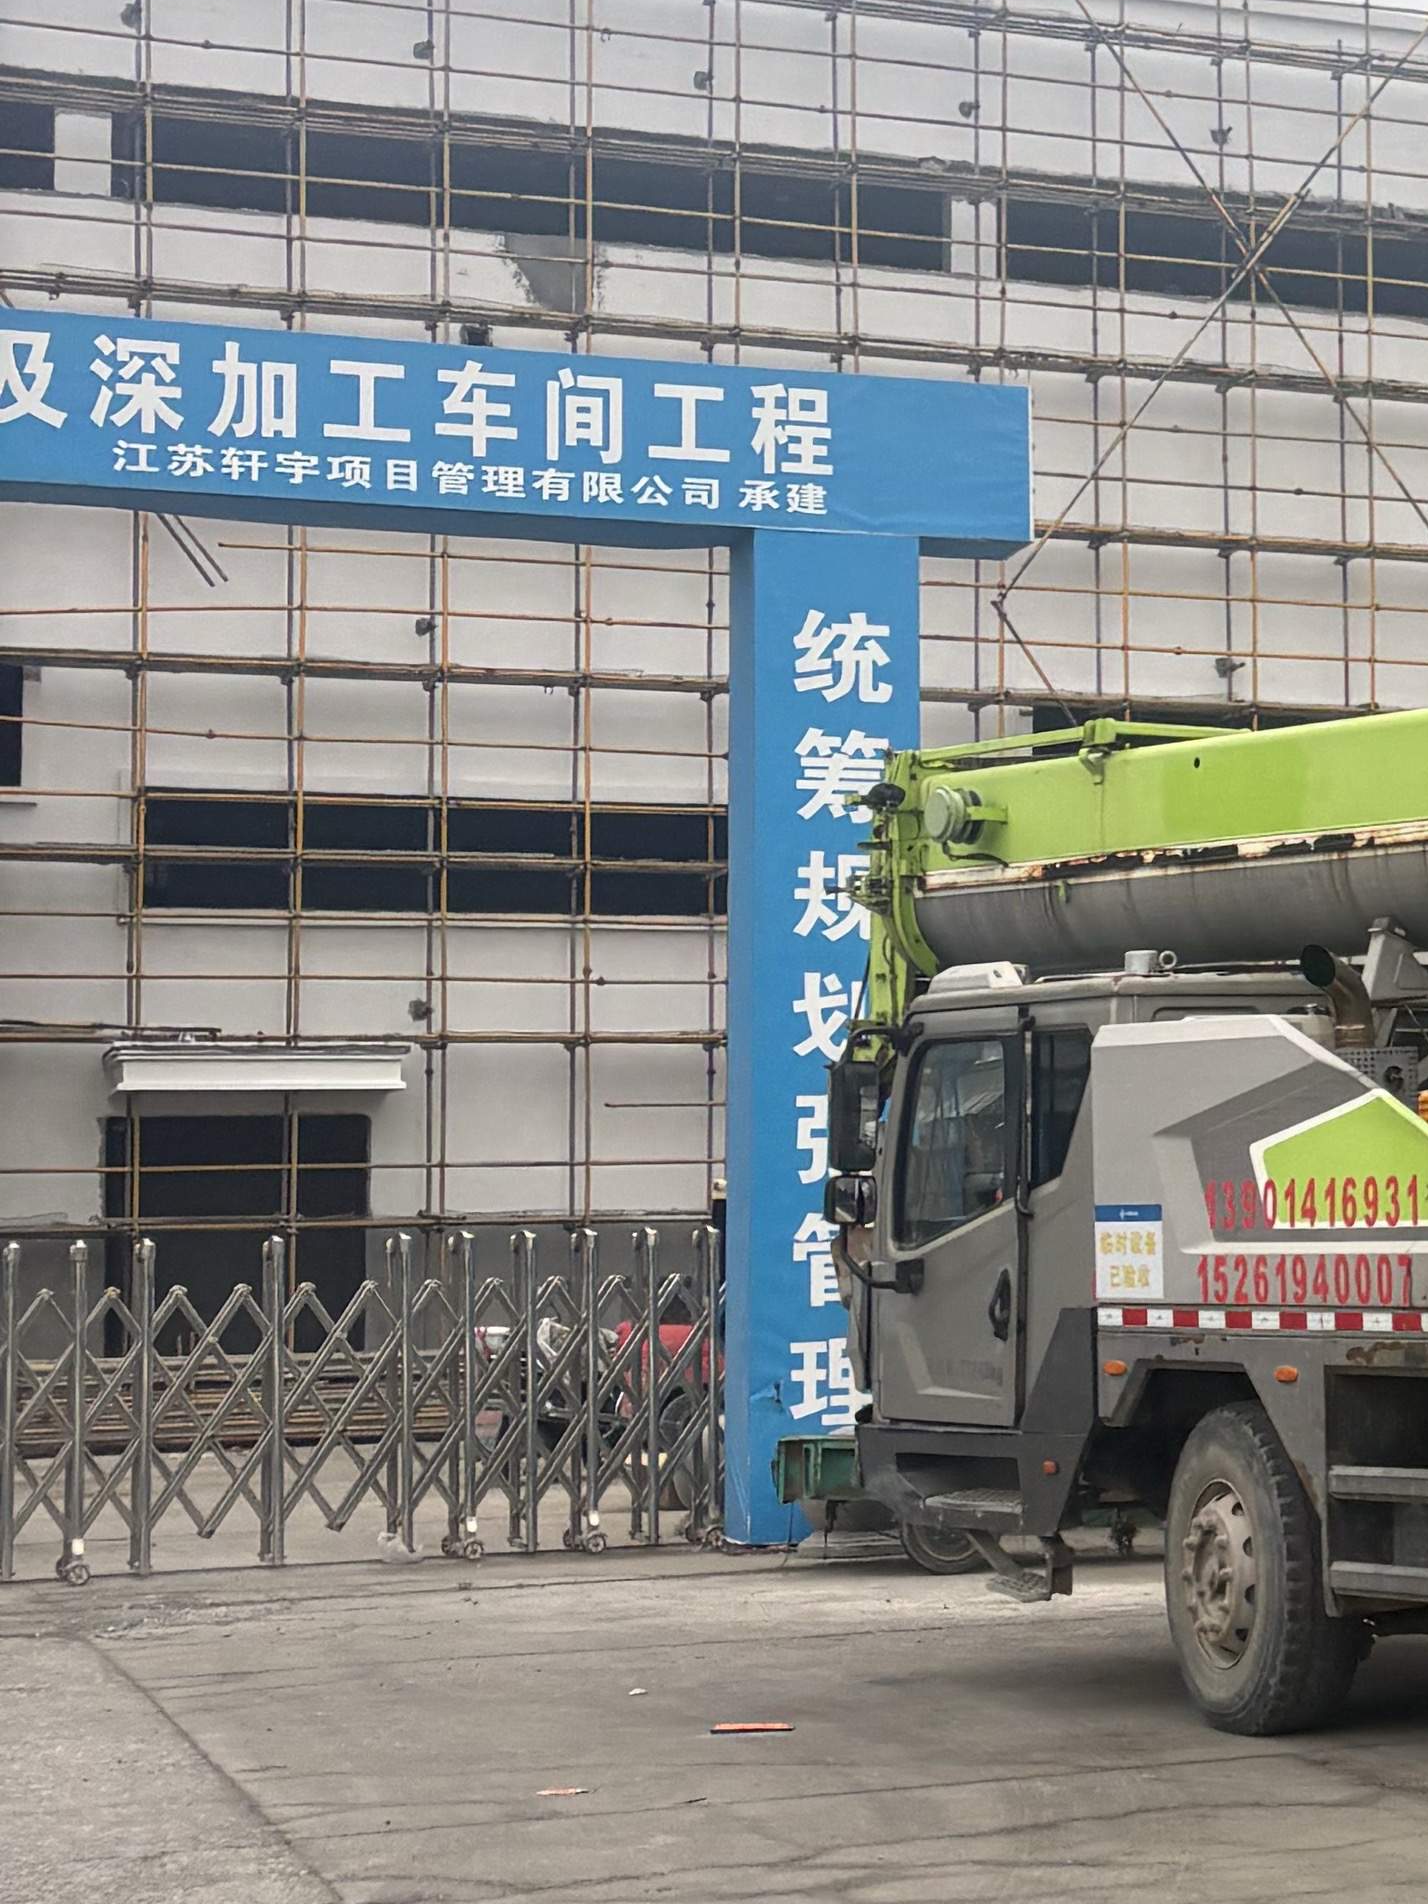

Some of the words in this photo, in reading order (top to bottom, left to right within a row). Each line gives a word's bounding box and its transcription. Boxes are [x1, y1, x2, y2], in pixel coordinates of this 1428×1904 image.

[0, 329, 833, 478] 及深加工车间工程
[112, 439, 720, 510] 江苏轩宇项目管理有限公司
[738, 479, 829, 516] 承建
[1204, 1174, 1419, 1230] 13901416931
[1196, 1253, 1413, 1306] 15261940007
